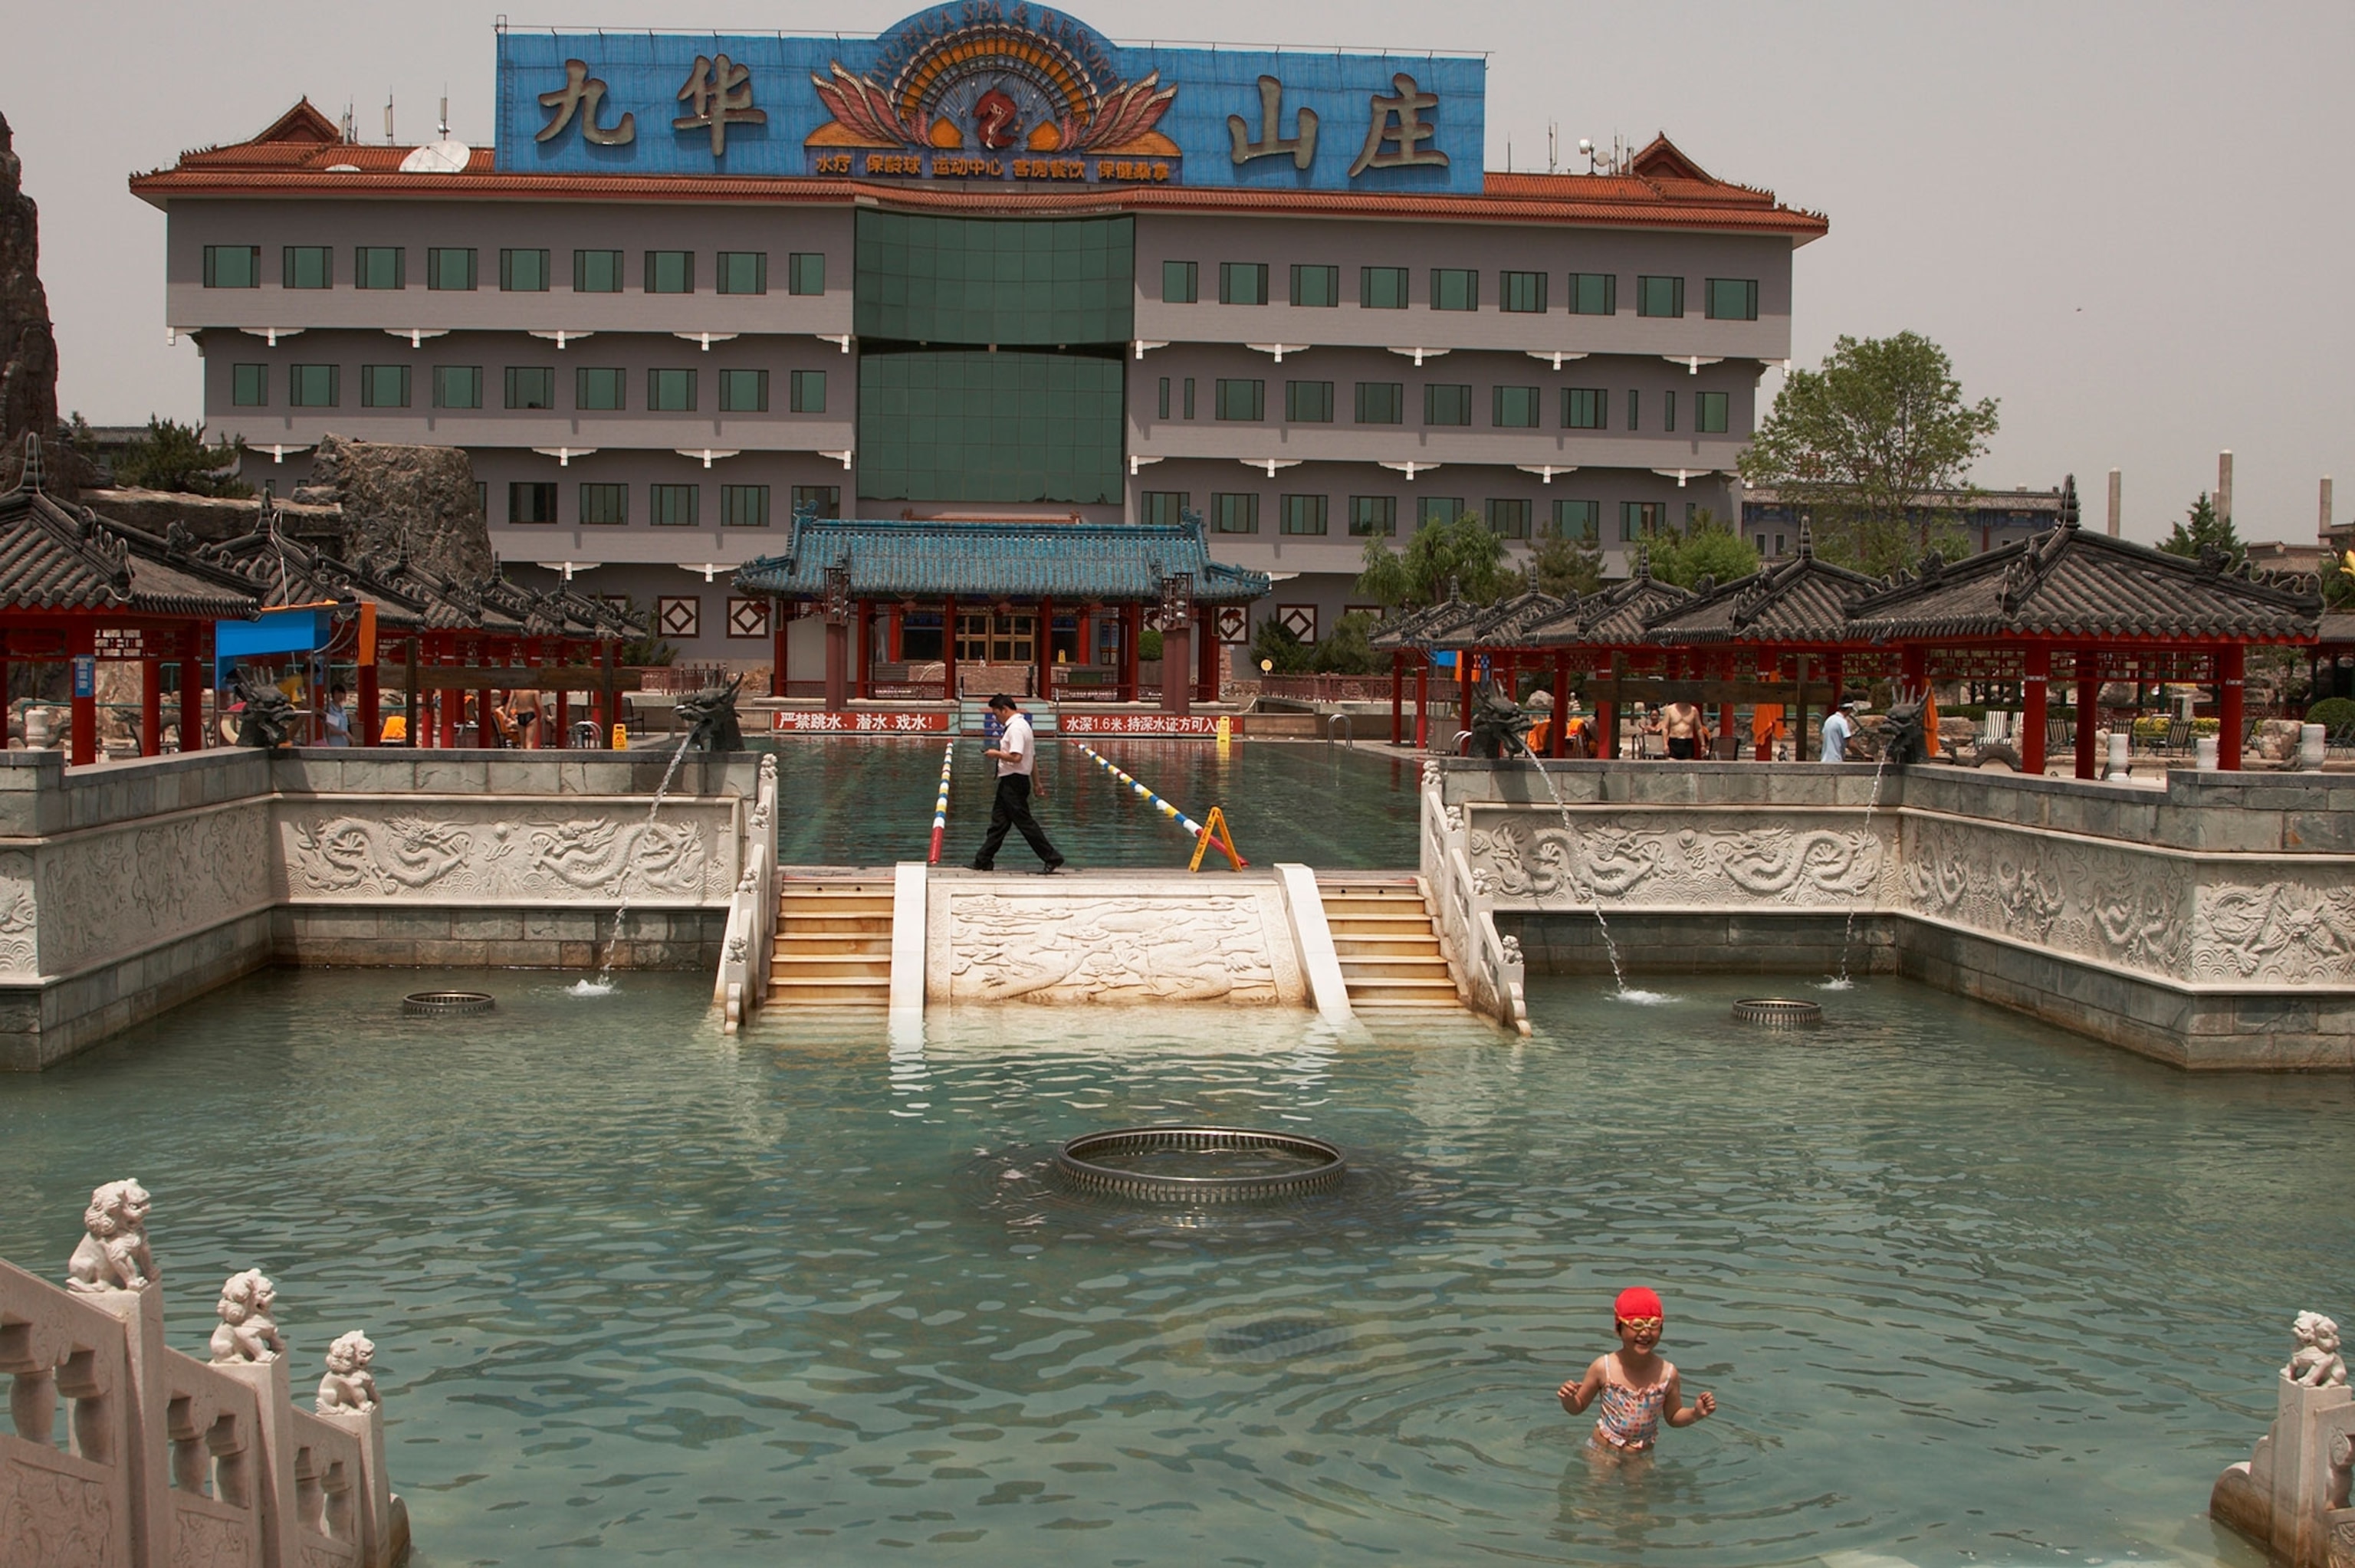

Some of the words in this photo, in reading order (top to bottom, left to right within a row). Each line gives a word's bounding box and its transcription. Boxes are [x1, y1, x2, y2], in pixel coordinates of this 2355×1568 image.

[871, 8, 956, 83] JIUHUA
[962, 0, 1003, 22] SPA
[1010, 2, 1029, 25] &
[1038, 9, 1120, 87] RESORT
[534, 54, 767, 156] 九华
[1228, 72, 1450, 178] 山庄
[816, 154, 852, 173] 水疗
[865, 153, 921, 174] 保龄球
[931, 156, 1004, 176] 运动中心
[1012, 158, 1086, 179] 客房餐饮
[1097, 159, 1170, 182] 保健桑拿
